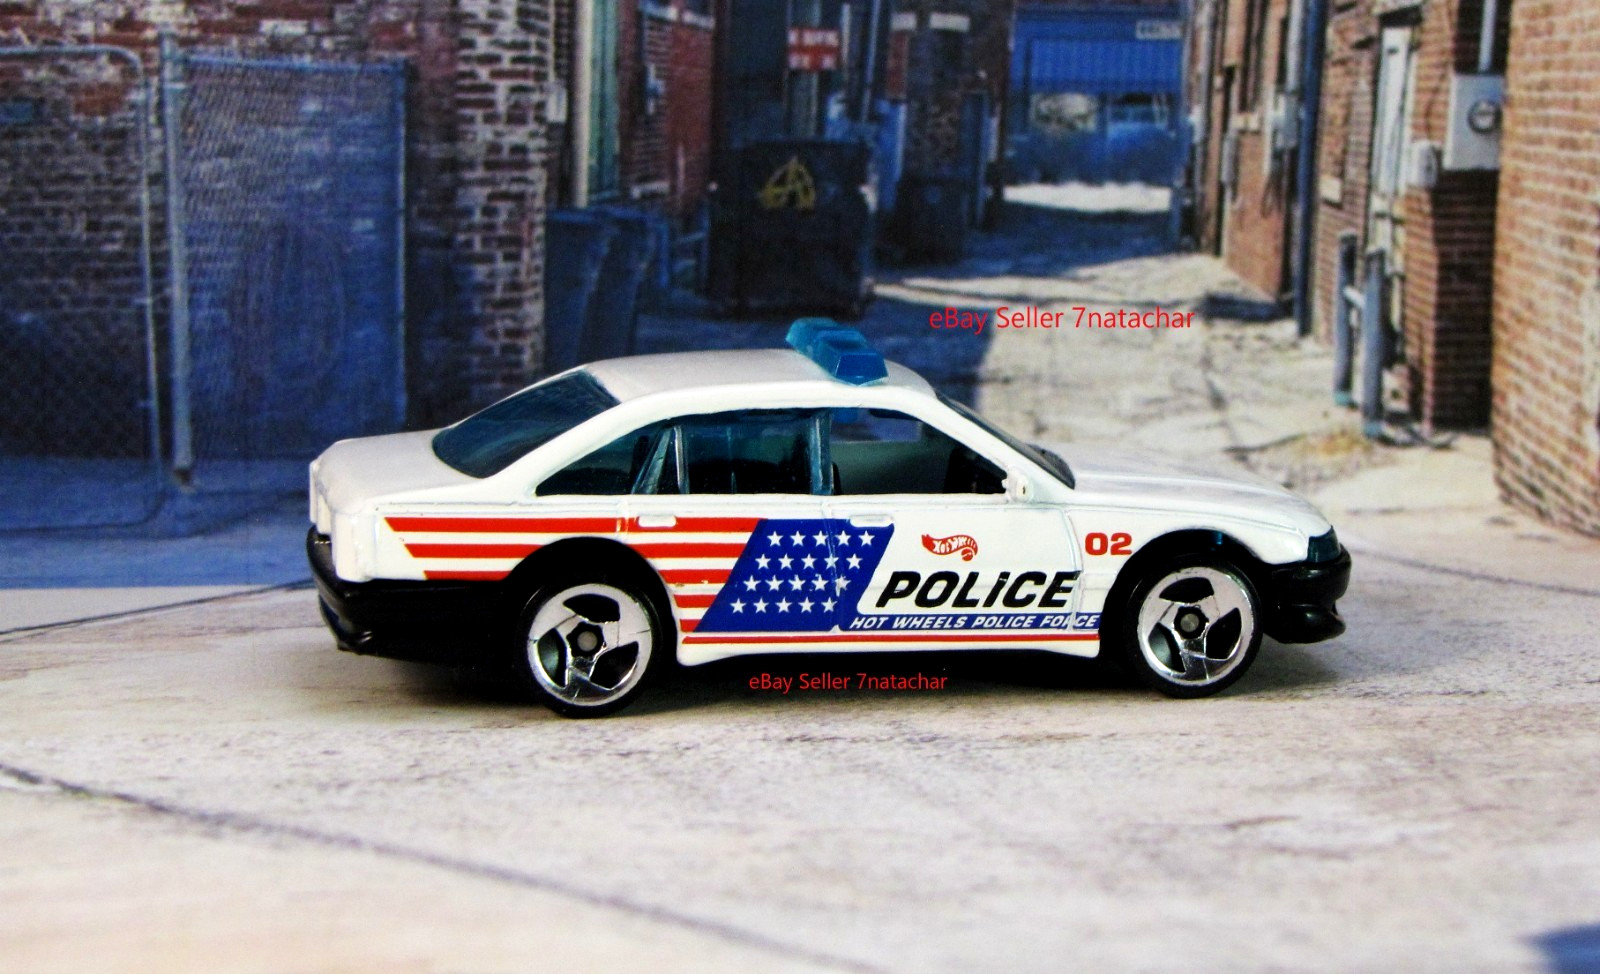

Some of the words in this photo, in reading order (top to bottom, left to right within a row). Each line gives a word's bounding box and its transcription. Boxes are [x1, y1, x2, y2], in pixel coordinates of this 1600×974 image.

[1084, 532, 1133, 556] 02
[875, 570, 1082, 608] POLICE
[850, 616, 888, 629] HOT
[892, 616, 967, 629] WHEELS
[971, 615, 1036, 629] POLICE
